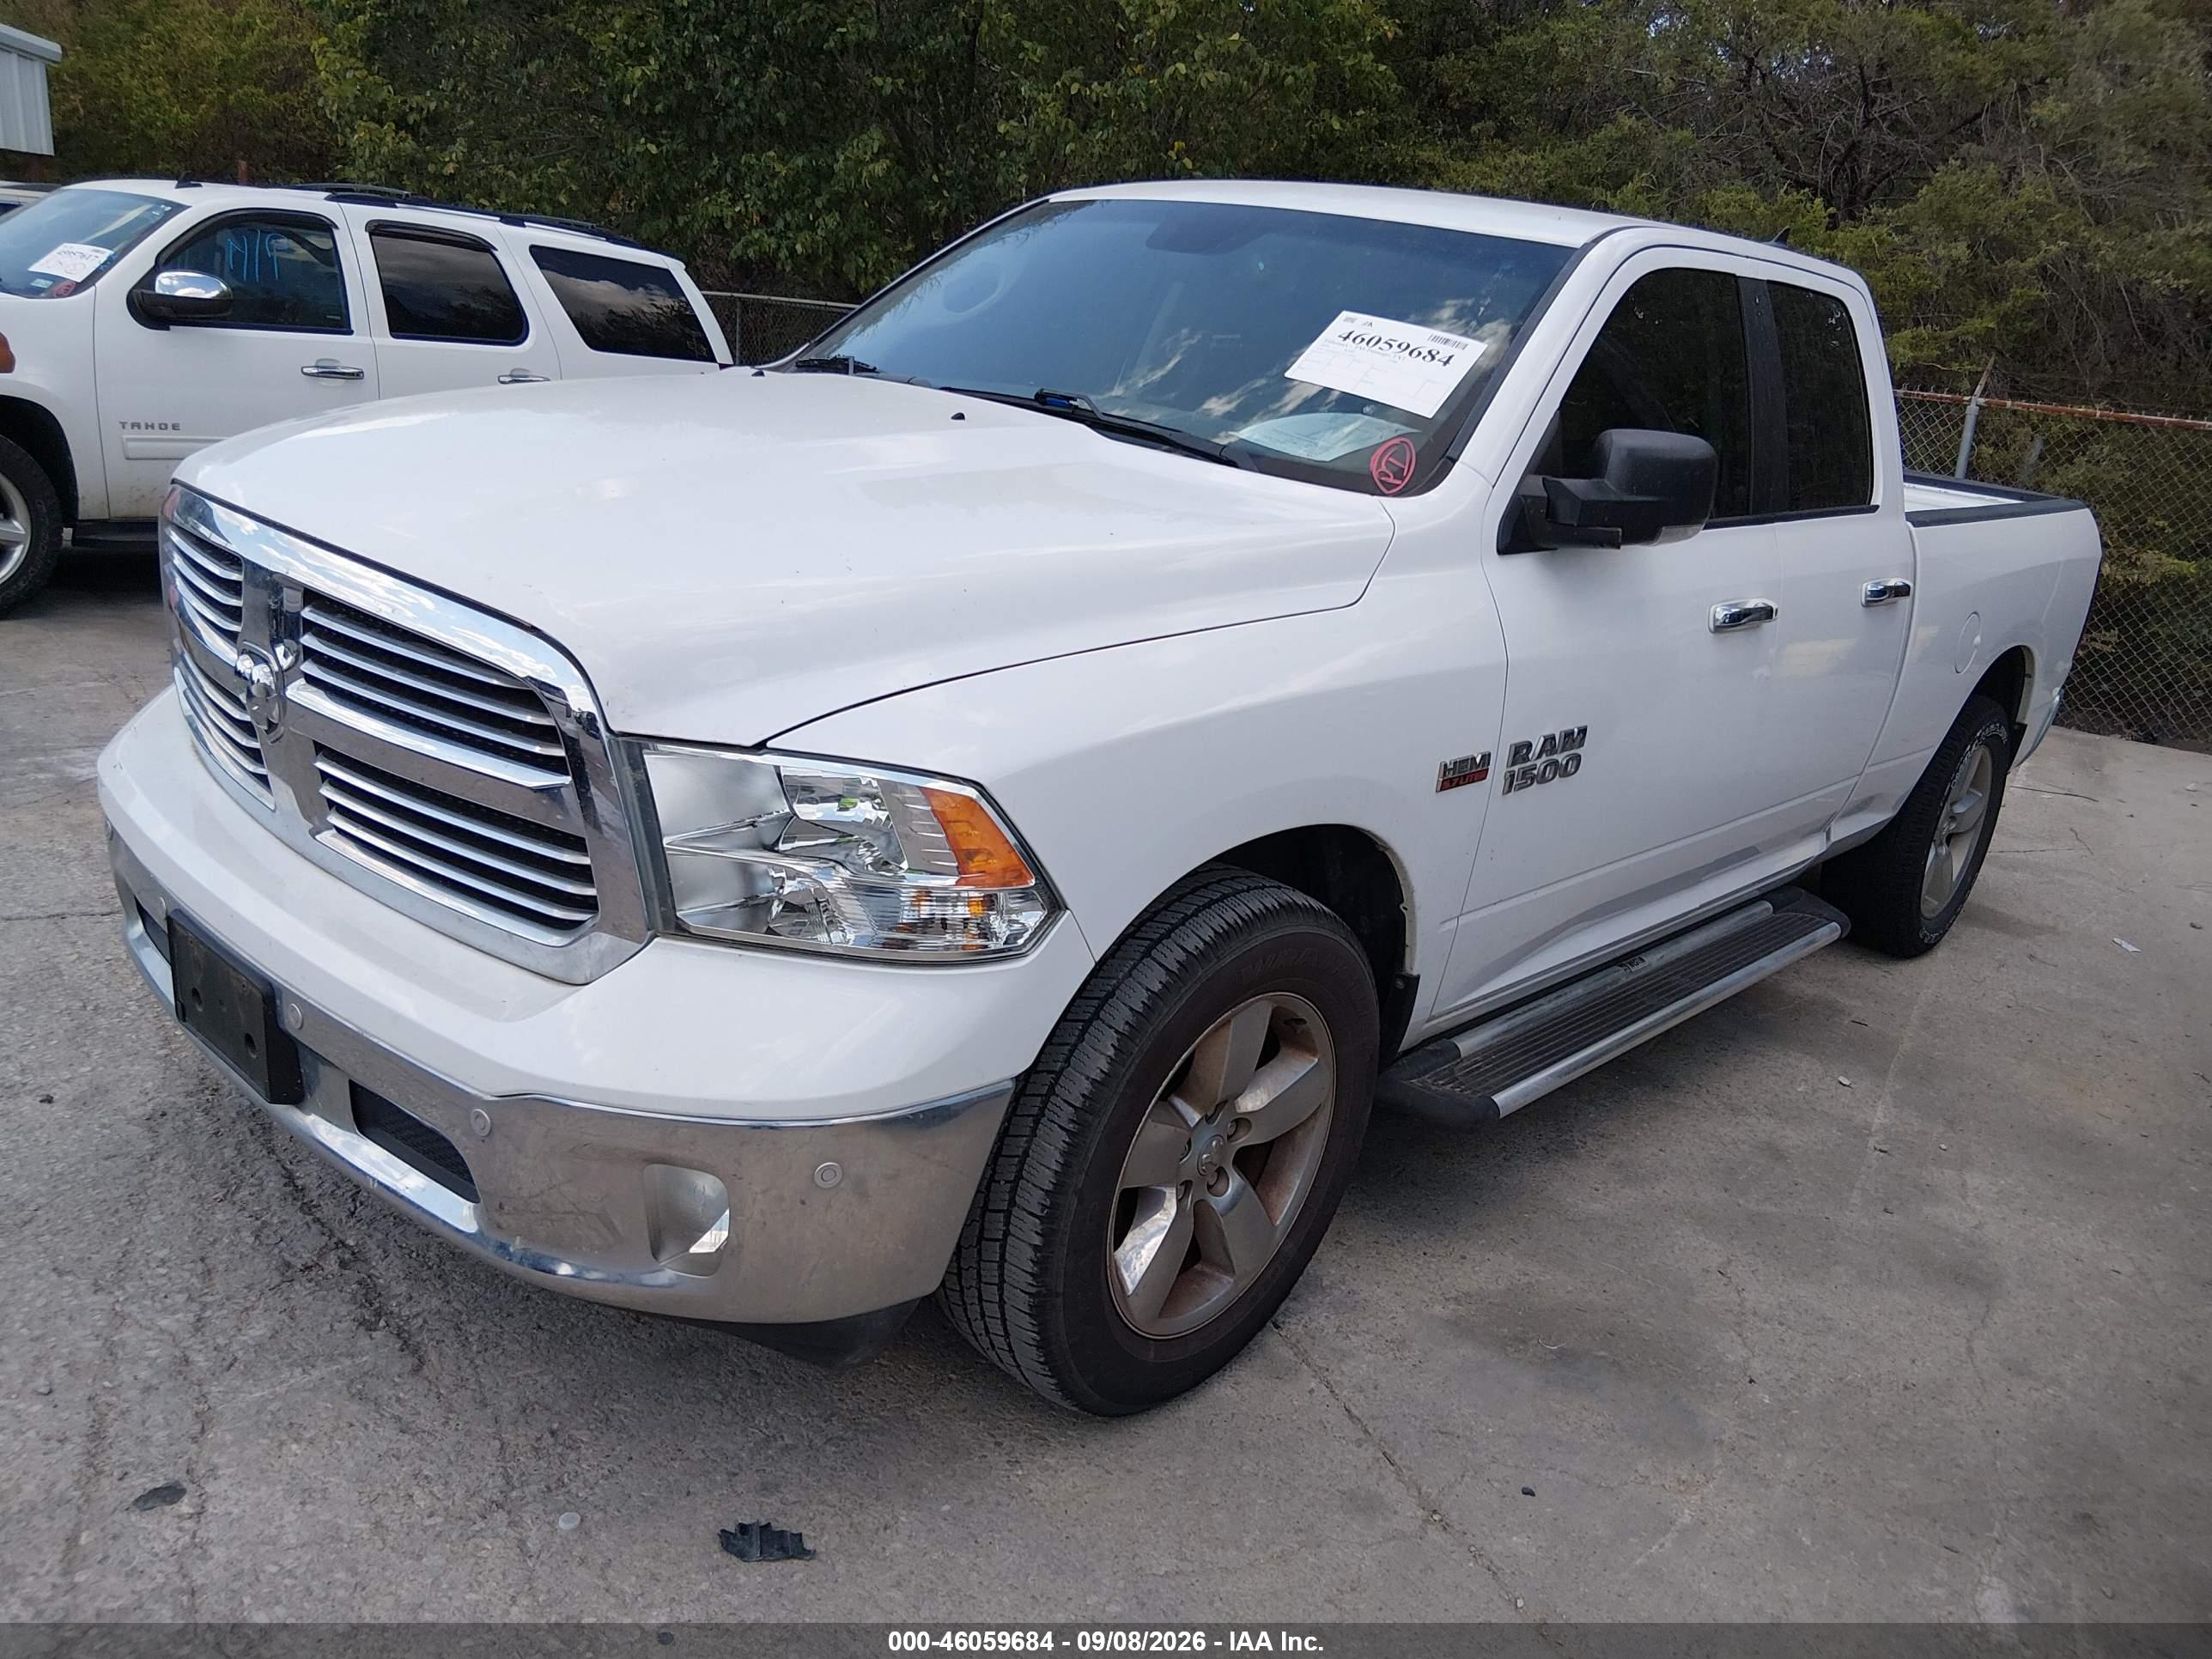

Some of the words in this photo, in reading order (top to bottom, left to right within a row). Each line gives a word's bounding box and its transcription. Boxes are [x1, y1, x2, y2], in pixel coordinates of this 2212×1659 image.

[1338, 330, 1455, 368] 46059684
[118, 421, 181, 431] TAHOE
[1506, 726, 1588, 769] RAM
[1502, 752, 1582, 796] 1500
